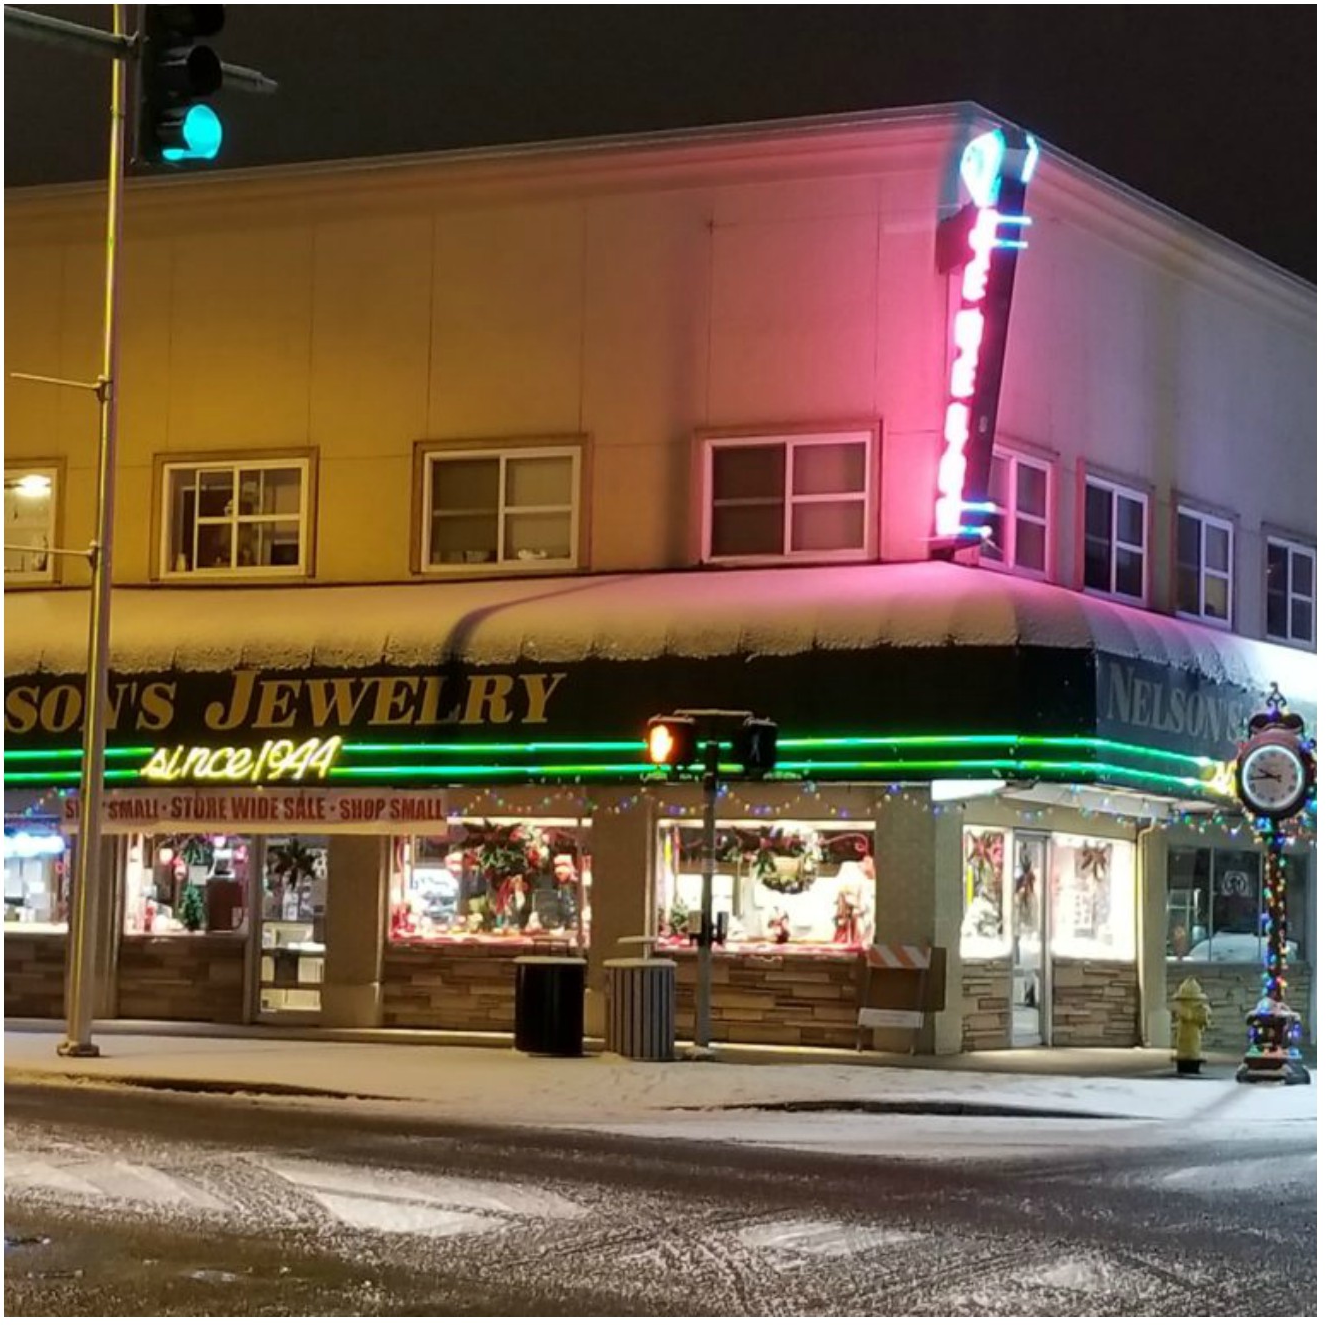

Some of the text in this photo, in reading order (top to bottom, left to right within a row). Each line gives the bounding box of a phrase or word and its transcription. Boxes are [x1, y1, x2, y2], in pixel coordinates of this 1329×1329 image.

[203, 670, 567, 731] JEWELRY
[139, 735, 342, 782] since 1944
[108, 798, 158, 819] SMALL
[170, 796, 227, 820] STORE
[231, 796, 279, 820] WIDE
[284, 796, 326, 820] SALE
[339, 797, 386, 820] SHOP
[389, 797, 444, 820] SMALL
